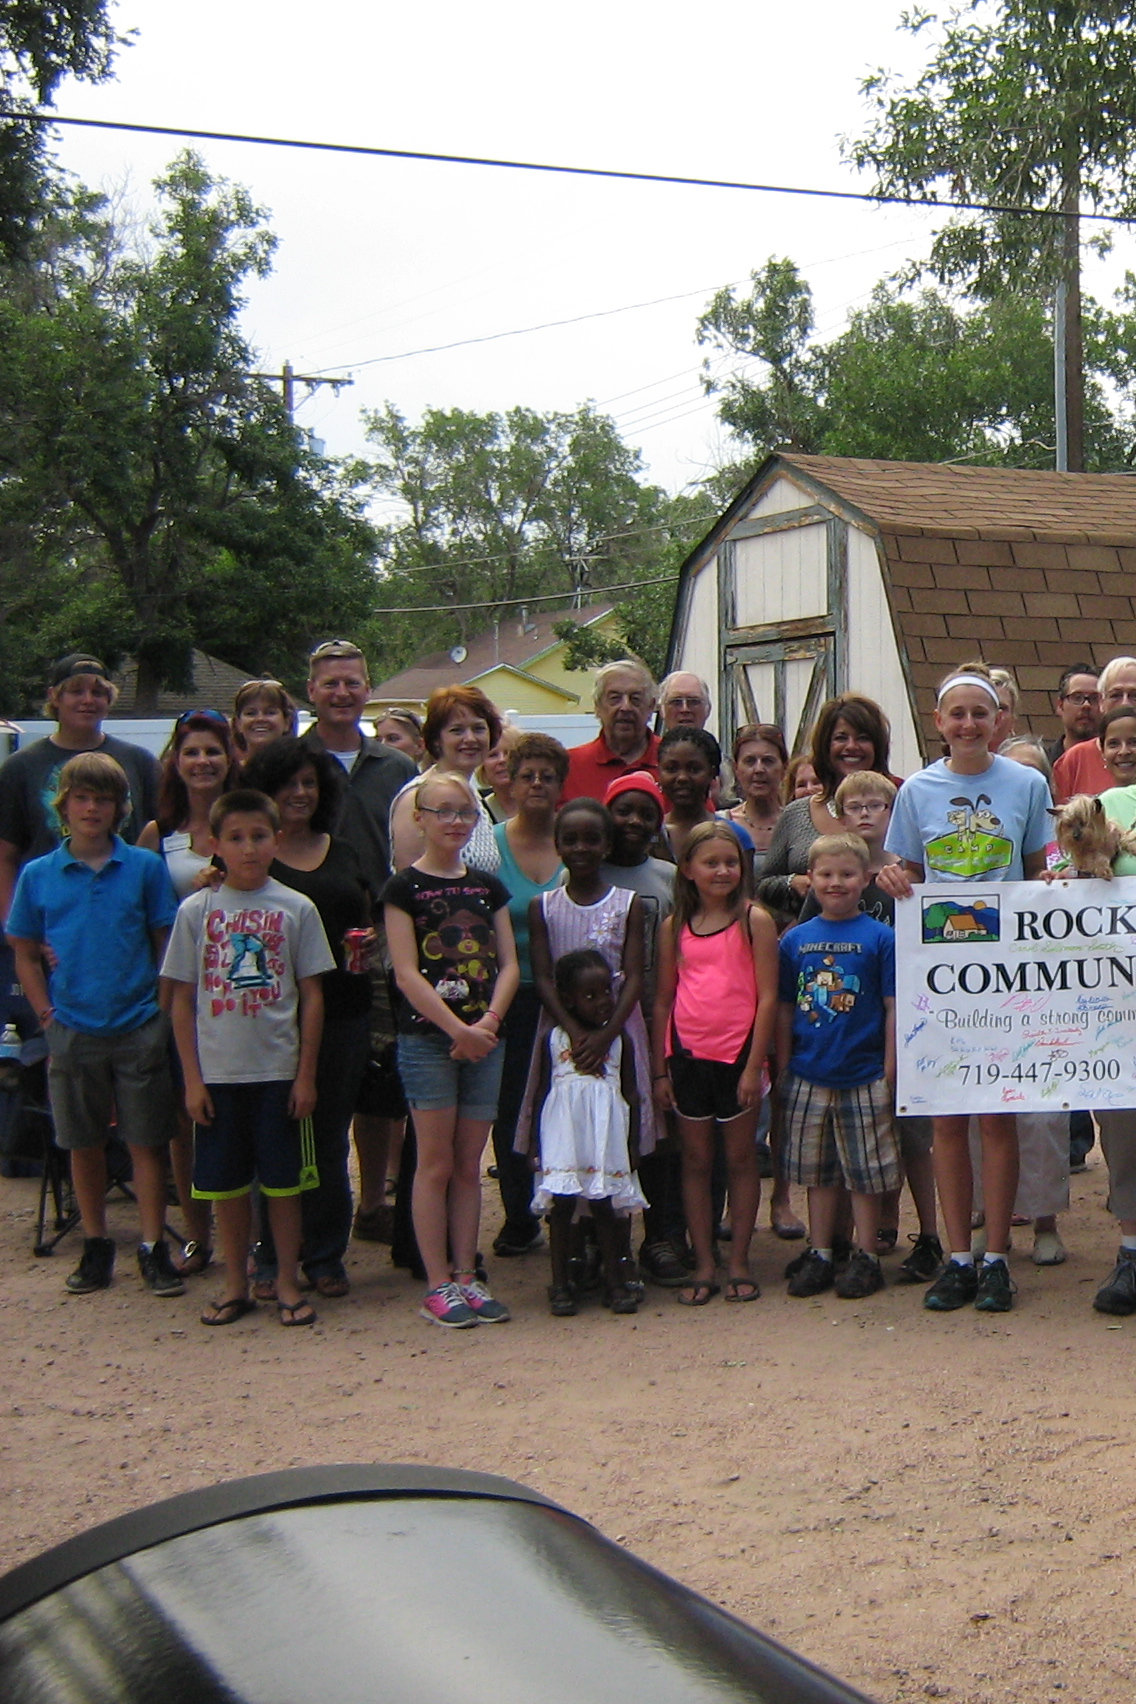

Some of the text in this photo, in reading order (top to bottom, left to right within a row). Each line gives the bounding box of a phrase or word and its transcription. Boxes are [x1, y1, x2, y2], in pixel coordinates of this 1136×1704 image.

[944, 844, 994, 854] CAMP
[1021, 1014, 1031, 1027] a
[1039, 1009, 1089, 1030] strong
[958, 1058, 1121, 1086] 719-447-9300
